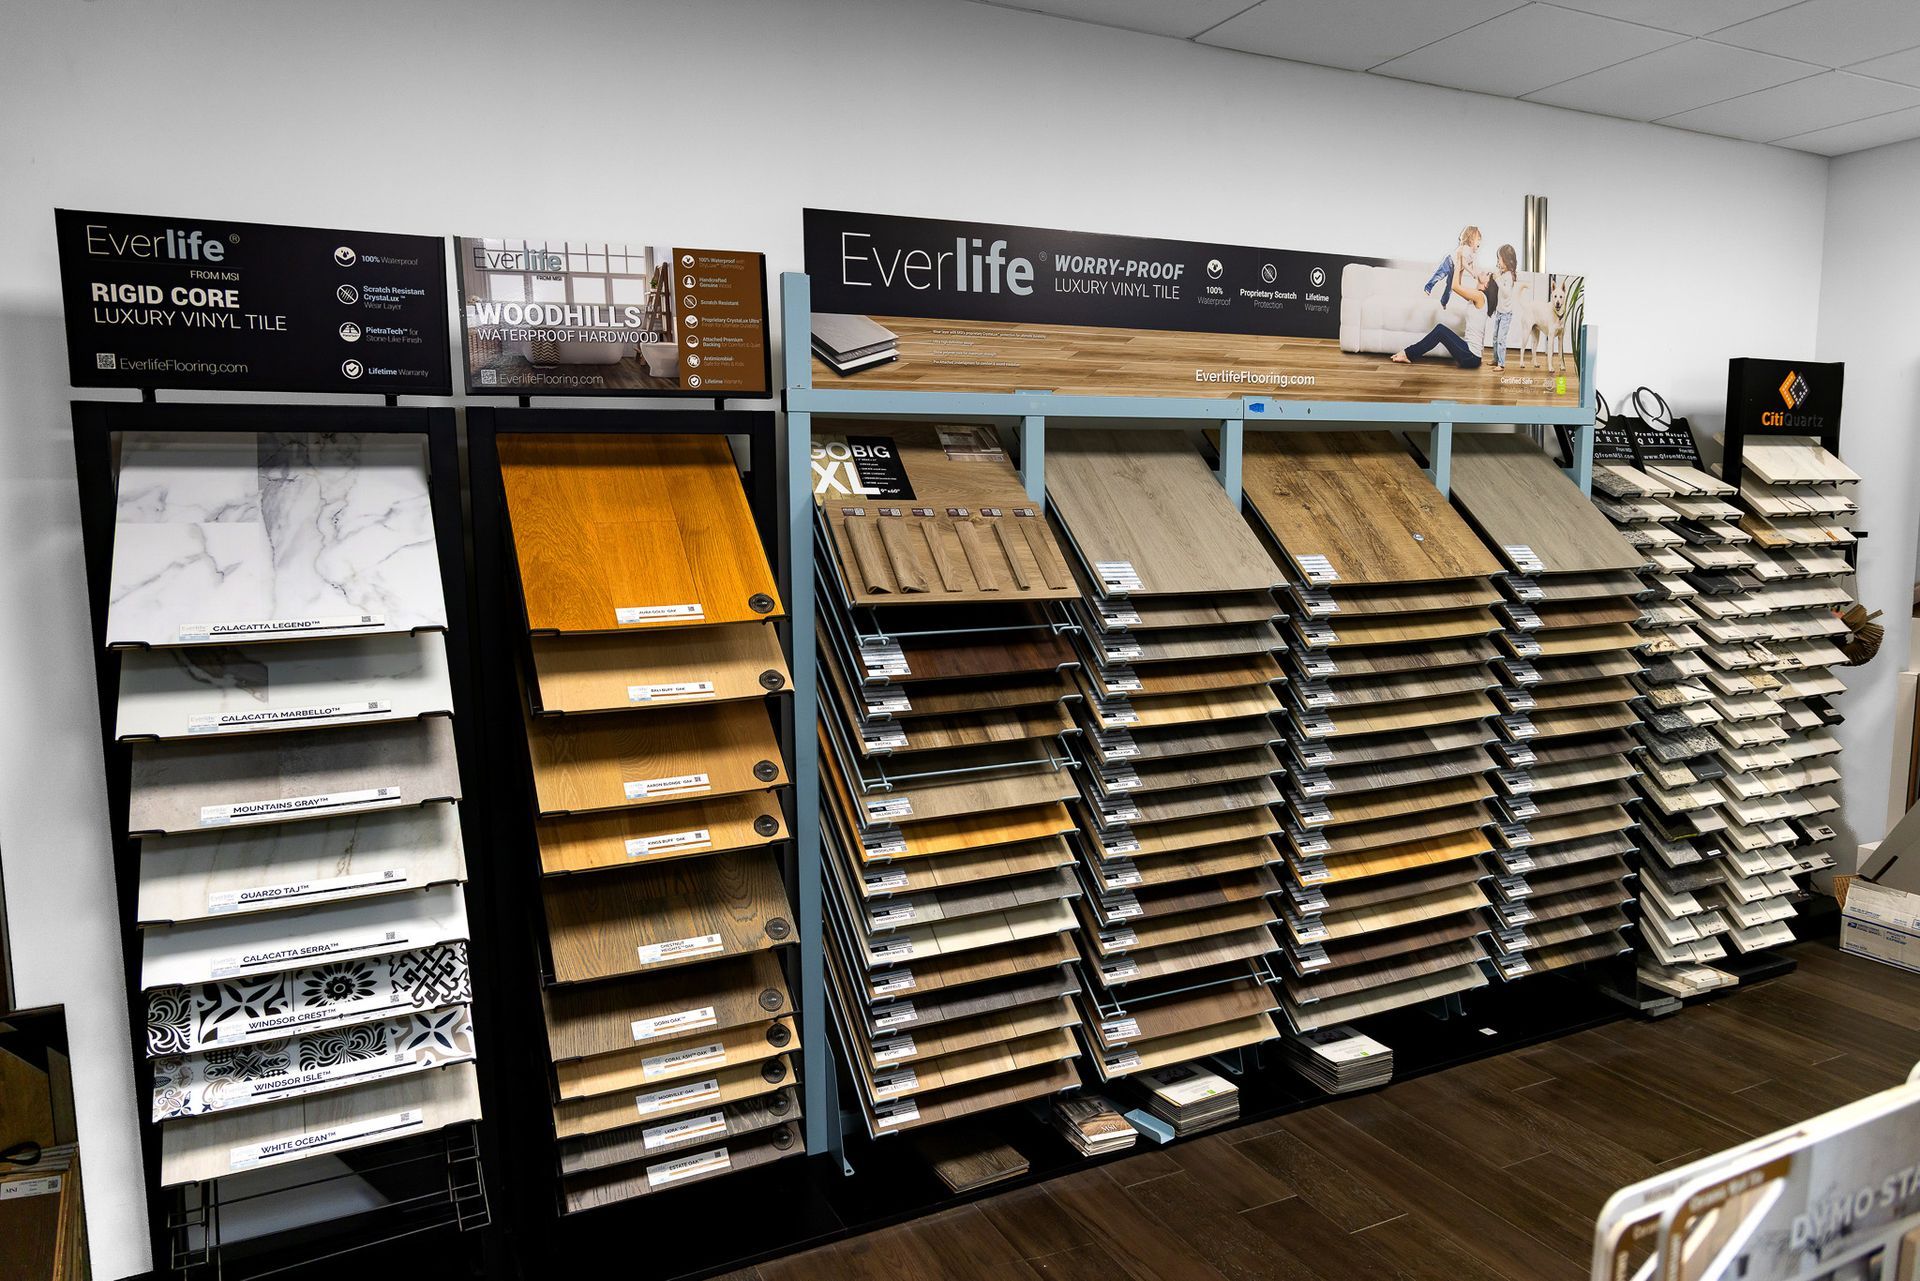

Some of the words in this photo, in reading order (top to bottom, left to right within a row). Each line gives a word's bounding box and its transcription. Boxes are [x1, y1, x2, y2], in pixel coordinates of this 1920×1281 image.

[87, 224, 225, 262] Everlife
[362, 255, 380, 263] 100%
[380, 257, 418, 266] Waterproof
[473, 247, 562, 271] Everlife
[842, 231, 1035, 297] Everlife
[1055, 254, 1184, 281] WORRY-PROOF
[190, 270, 216, 280] FROM
[218, 271, 240, 281] MSI
[91, 283, 164, 305] RIGID
[171, 286, 240, 308] CORE
[363, 286, 391, 294] Scratch
[392, 287, 425, 296] Resistant
[1055, 278, 1110, 295] LUXURY
[1112, 281, 1150, 298] VINYL
[1152, 284, 1180, 300] TILE
[1206, 286, 1223, 295] 100%
[1240, 288, 1273, 299] Proprietary
[1275, 291, 1297, 300] Scratch
[1198, 297, 1231, 306] Waterproof
[1254, 300, 1284, 309] Protection
[1306, 293, 1329, 301] Lifetime
[383, 302, 402, 311] Layer
[94, 308, 176, 325] LUXURY
[181, 311, 241, 329] VINYL
[245, 314, 287, 331] TILE
[475, 302, 642, 329] WOODHILLS
[478, 328, 575, 343] WATERPROOF
[578, 330, 659, 344] HARDWOOD
[120, 358, 248, 375] EverlifeFlooring.com
[398, 369, 429, 378] Warranty
[500, 373, 604, 387] EverlifeFlooring.com
[1195, 369, 1315, 387] EverlifeFlooring.com
[1762, 411, 1824, 428] CitiQuartz
[851, 444, 891, 459] BIG
[811, 461, 881, 495] XL
[213, 621, 270, 632] CALACATTA
[221, 711, 279, 723] CALACATTA
[233, 800, 292, 814] MOUNTAINS
[240, 885, 282, 900] QUARZO
[242, 949, 299, 963] CALACATTA
[248, 1015, 296, 1030] WINDSOR
[664, 1054, 682, 1063] CORAL
[254, 1076, 302, 1092] WINDSOR
[261, 1140, 294, 1155] WHITE
[669, 1162, 688, 1171] ESTATE
[1790, 1189, 1873, 1250] DYMO
